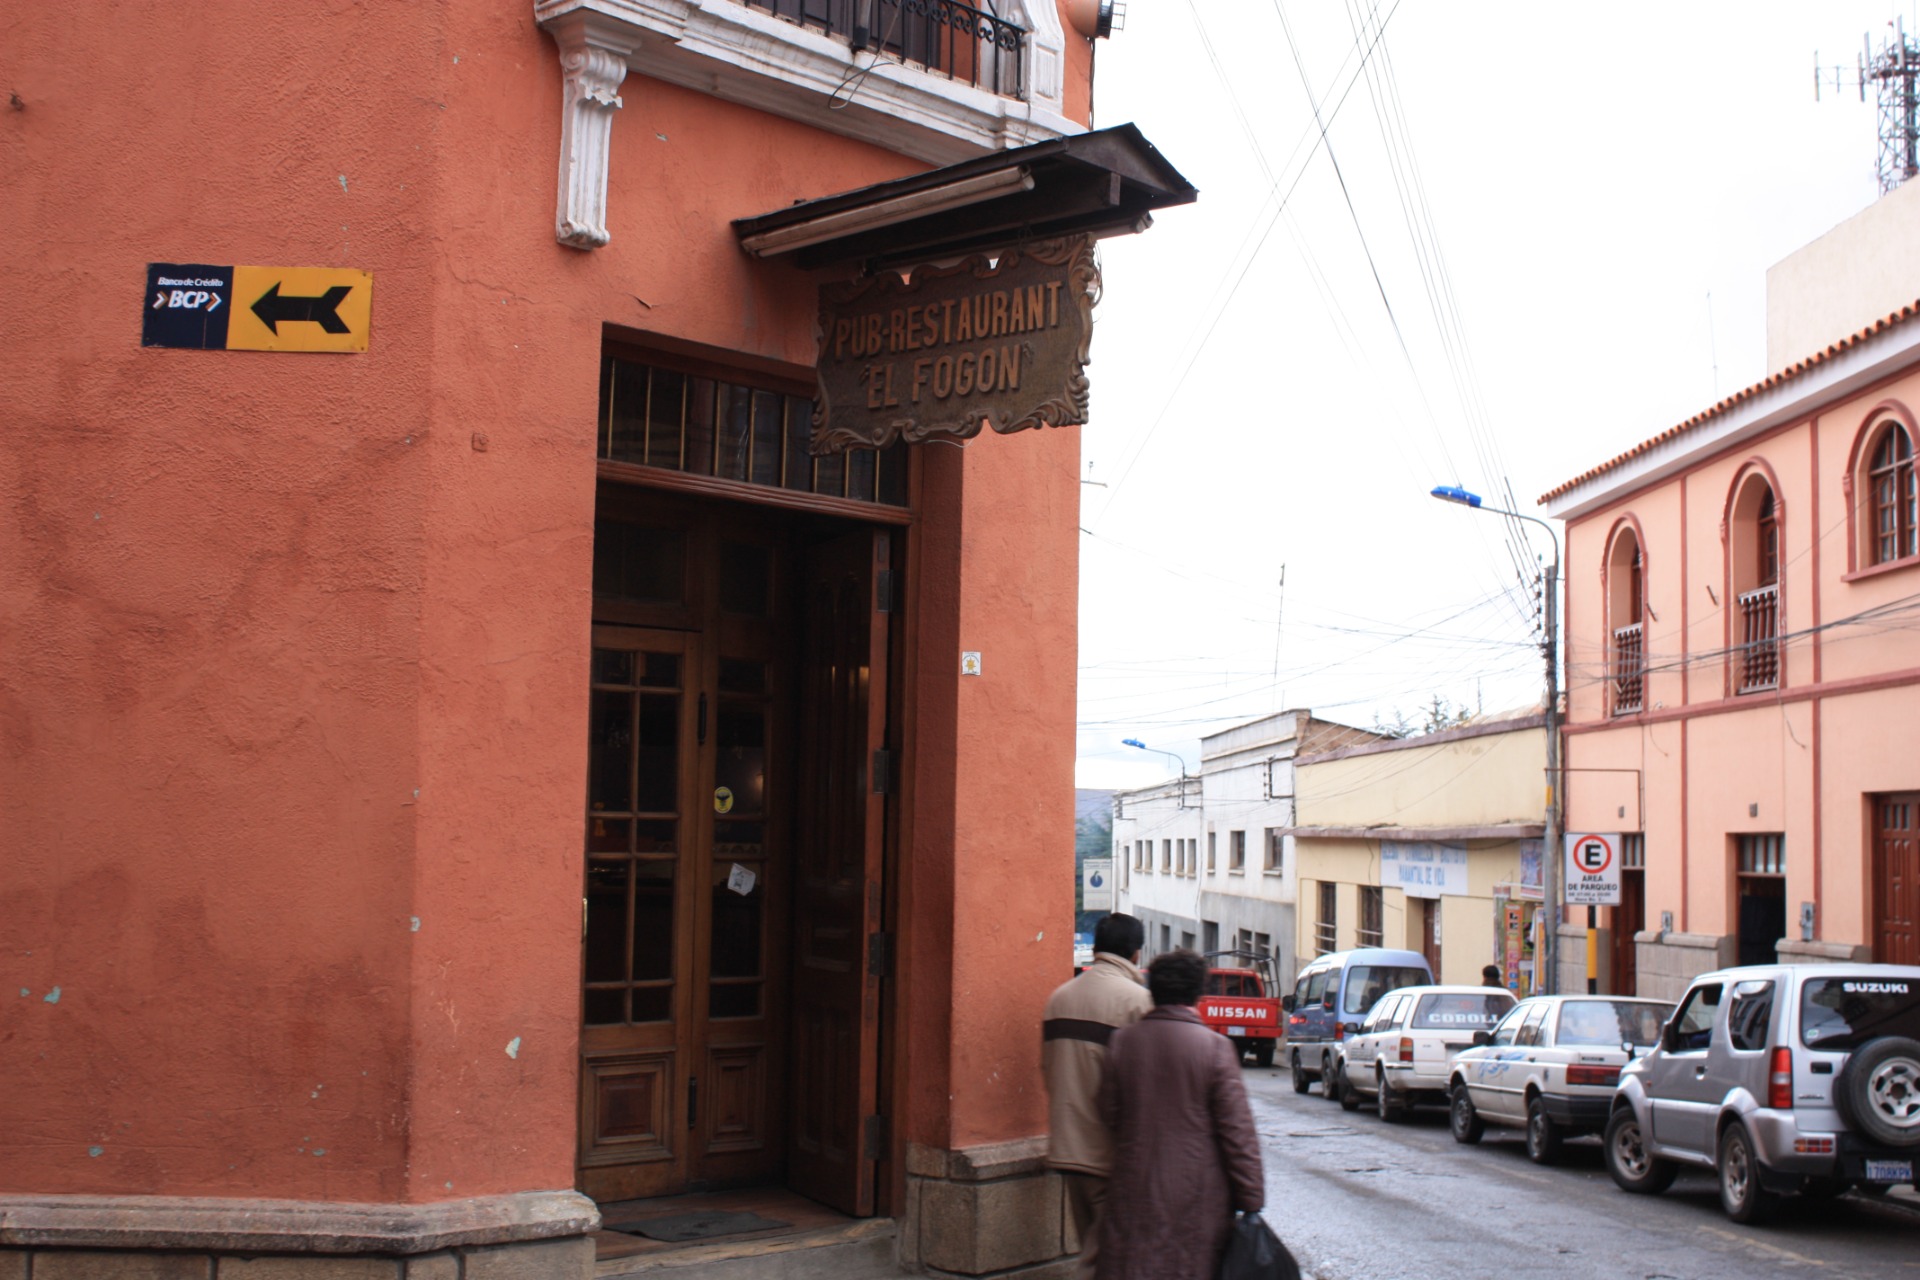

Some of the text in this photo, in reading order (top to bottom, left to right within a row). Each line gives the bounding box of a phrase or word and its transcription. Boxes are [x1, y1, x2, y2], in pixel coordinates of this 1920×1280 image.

[158, 276, 182, 286] Banco
[184, 278, 194, 286] de
[168, 290, 210, 309] BCP
[835, 281, 1062, 361] PUB-RESTAURANT
[1585, 844, 1602, 866] E
[1568, 883, 1618, 891] DE PARQUEO
[1843, 982, 1909, 994] SUZUKI
[1207, 1006, 1267, 1019] NISSAN
[1428, 1013, 1499, 1024] COROLL
